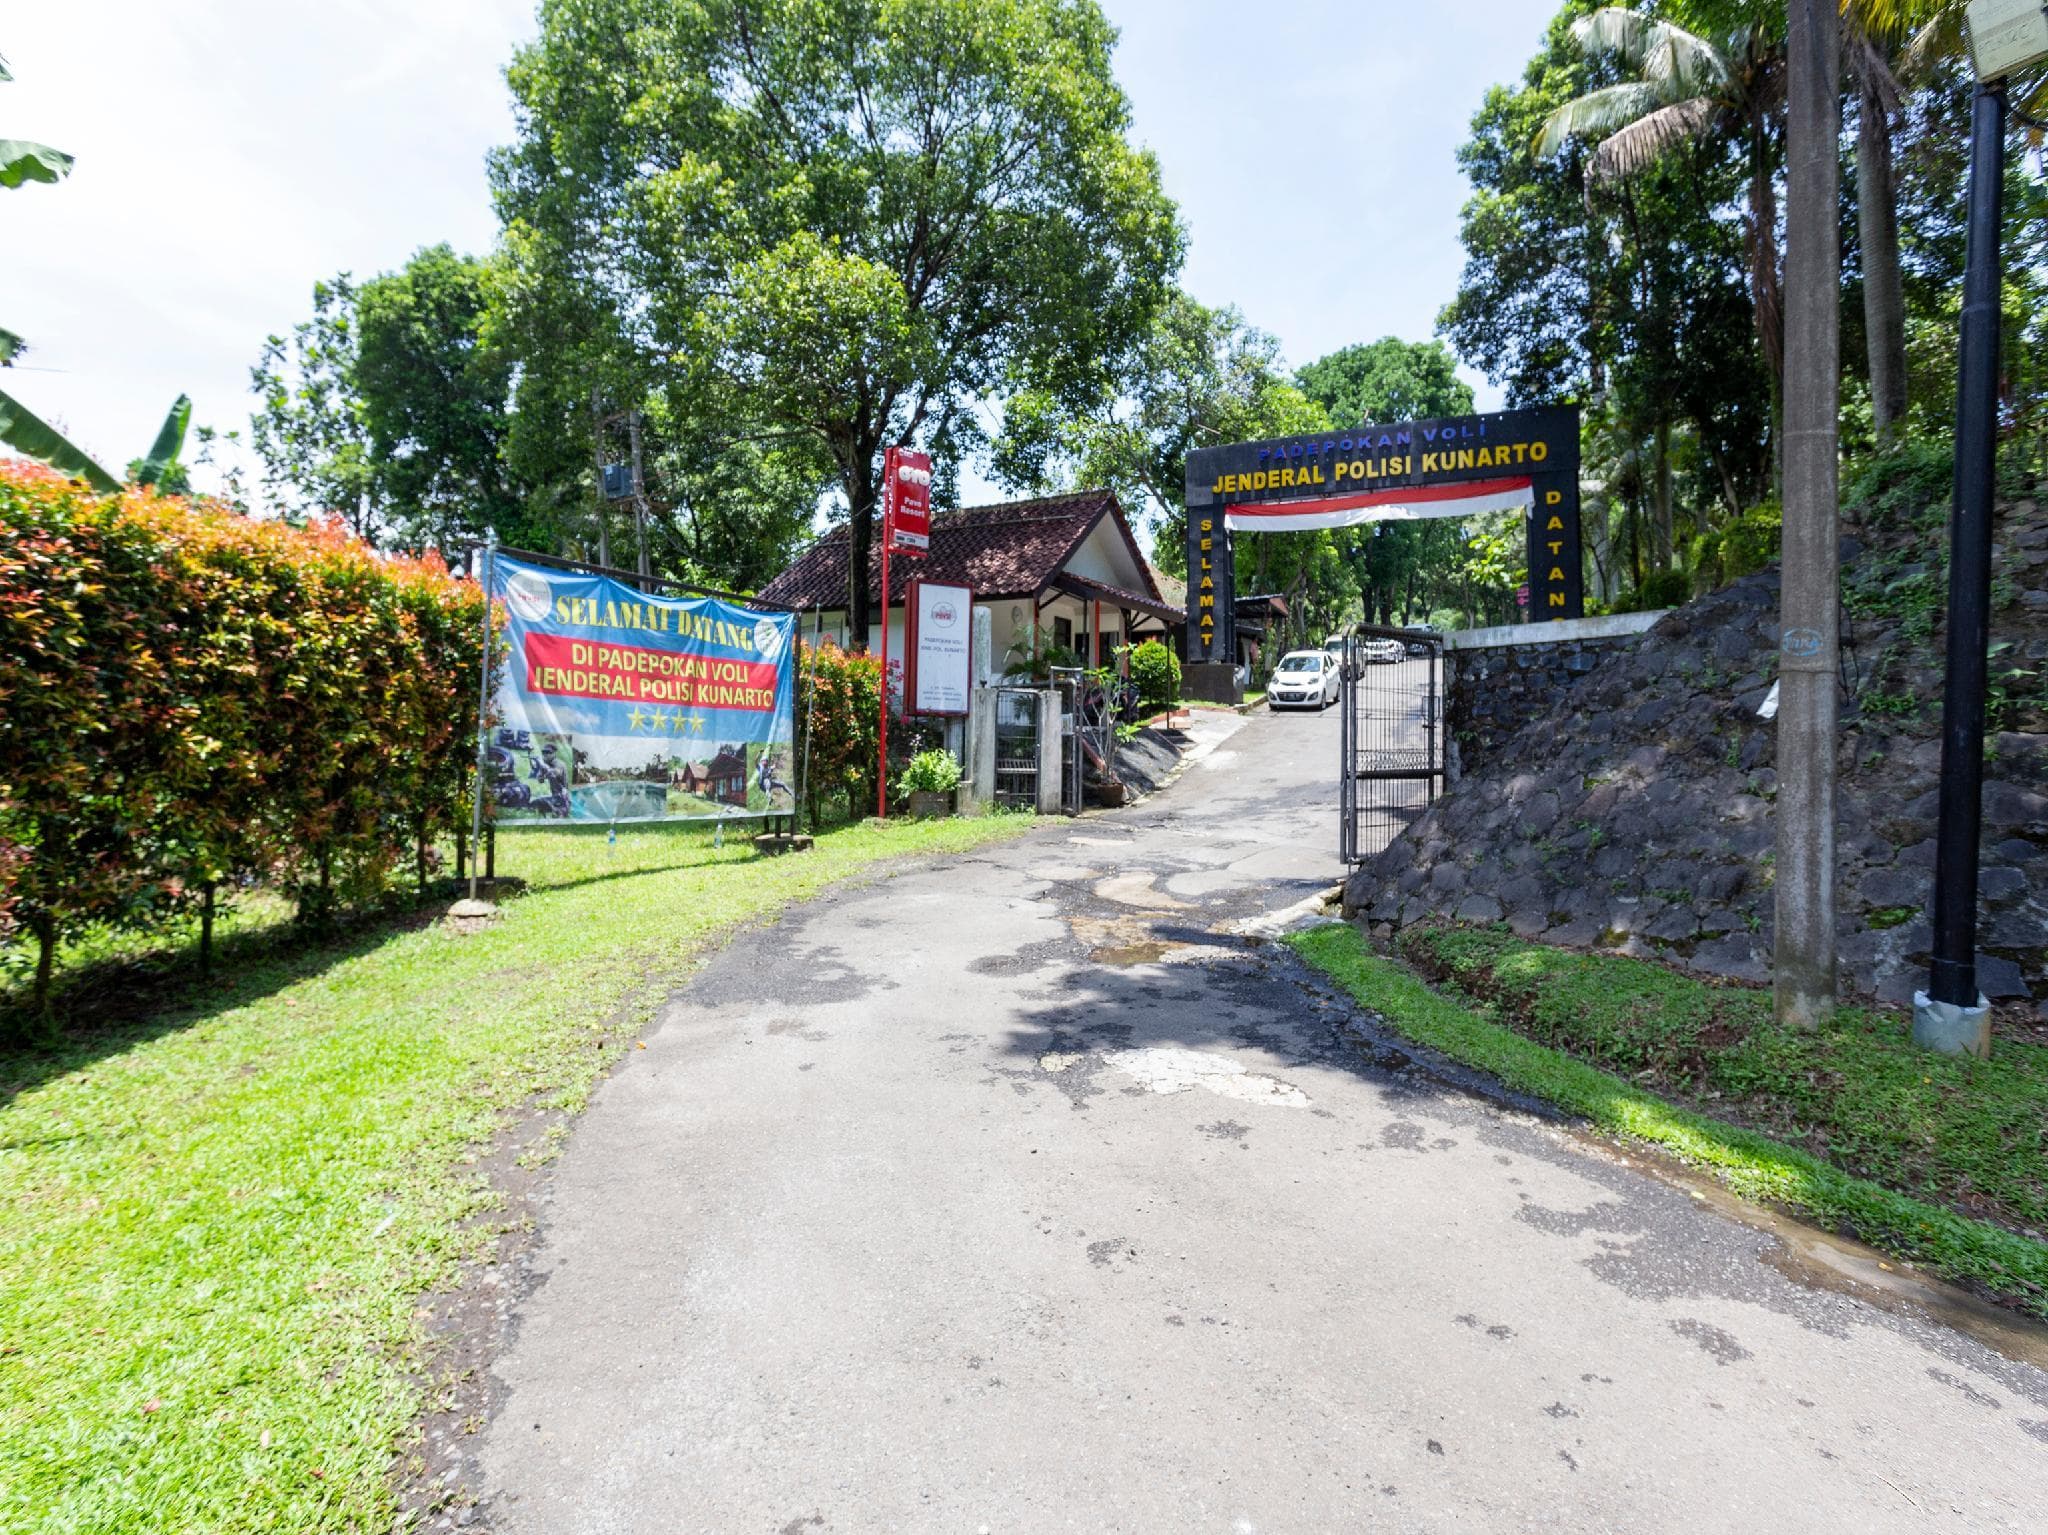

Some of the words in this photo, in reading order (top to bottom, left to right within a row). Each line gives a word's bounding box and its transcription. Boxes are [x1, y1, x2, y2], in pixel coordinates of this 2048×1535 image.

[1212, 465, 1326, 494] JENDERAL
[1335, 455, 1412, 481] POLISI
[1422, 441, 1548, 473] KUNARTO
[1258, 431, 1411, 461] PADEPOKAN
[1423, 423, 1486, 441] VOLI
[1200, 519, 1214, 646] SELAMAT
[1545, 490, 1565, 622] DATAN
[556, 596, 673, 632] SELAMAT
[678, 609, 753, 652] DATANG
[534, 667, 636, 697] JENDERAL
[640, 678, 694, 702] POLISI
[697, 684, 774, 708] KUNARTO
[571, 643, 593, 666] DI
[598, 647, 707, 680] PADEPOKAN
[711, 662, 749, 684] VOLI
